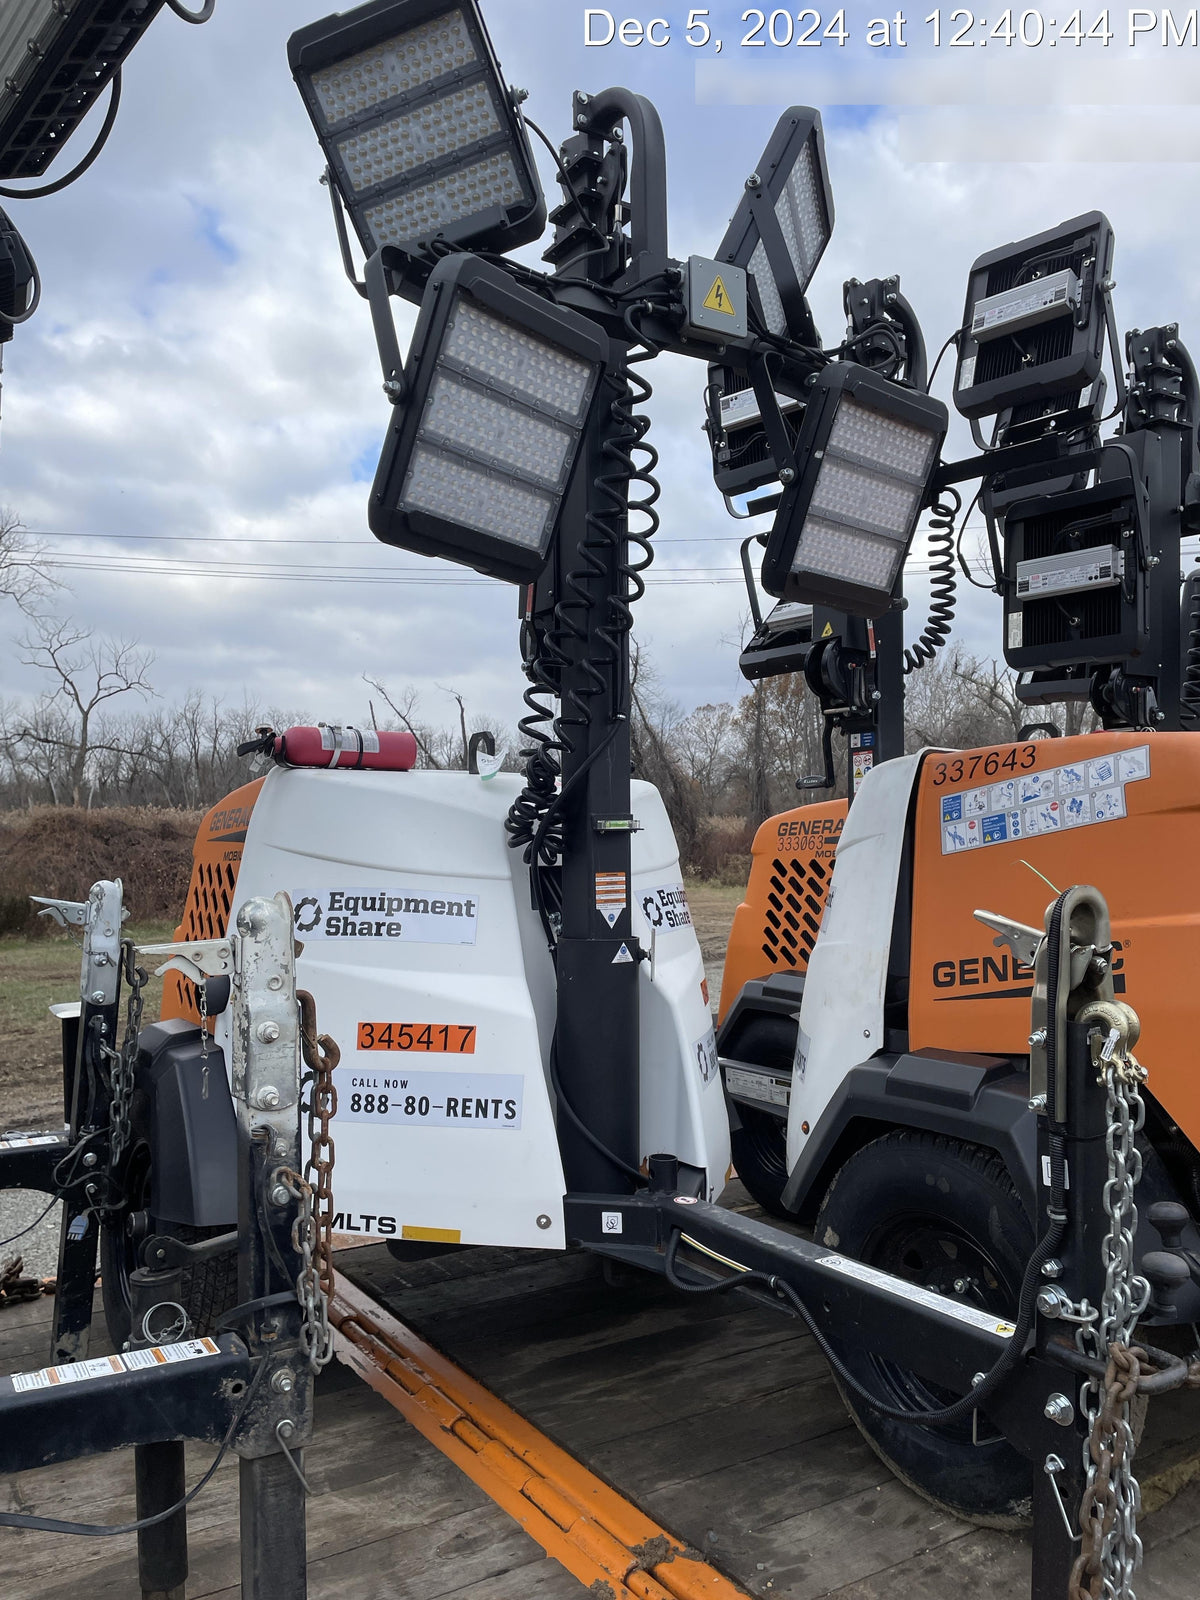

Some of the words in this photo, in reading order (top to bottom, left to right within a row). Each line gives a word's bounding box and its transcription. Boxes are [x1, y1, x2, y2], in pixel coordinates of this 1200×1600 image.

[933, 744, 1037, 786] 337643
[209, 804, 256, 832] GENERA
[777, 834, 825, 852] 333063
[327, 891, 476, 918] Equipment
[324, 916, 403, 938] Share
[932, 940, 1124, 988] GENEC
[360, 1022, 475, 1053] 345417
[351, 1077, 379, 1089] CALL
[383, 1079, 409, 1090] NOW
[350, 1092, 517, 1121] 888-80-RENTS
